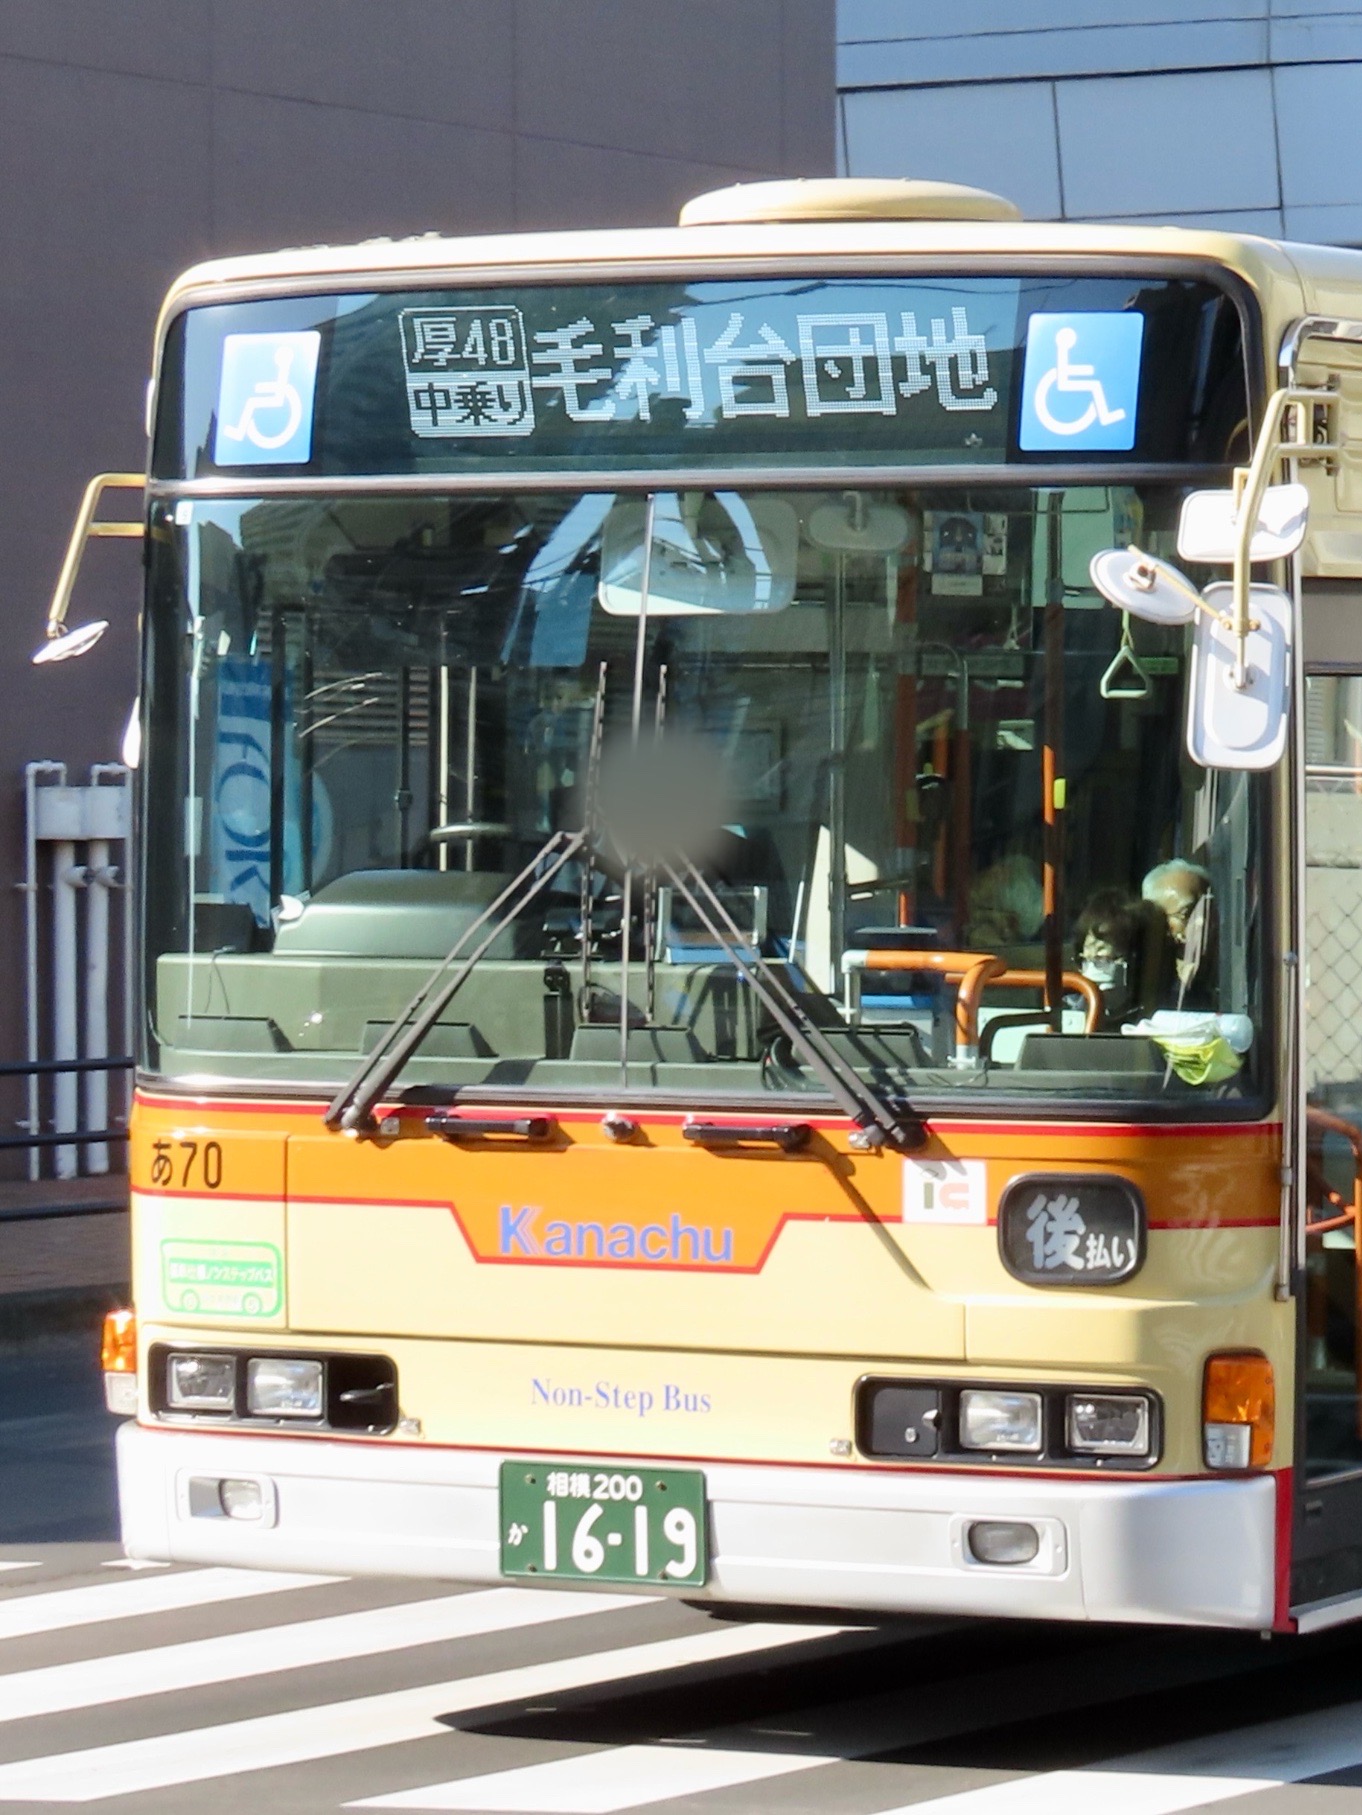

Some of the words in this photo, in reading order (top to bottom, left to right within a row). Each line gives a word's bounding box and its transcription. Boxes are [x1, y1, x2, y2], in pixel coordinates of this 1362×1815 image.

[412, 317, 516, 366] 厚48
[531, 307, 999, 422] 毛利台団地
[413, 381, 527, 427] 中乗り
[151, 1138, 223, 1189] あ70
[500, 1206, 733, 1262] Kanachu
[1025, 1193, 1137, 1270] 後払い
[531, 1377, 654, 1418] Non-Step
[662, 1383, 712, 1413] Bus
[546, 1471, 643, 1502] 相模200
[507, 1522, 529, 1546] か
[543, 1500, 697, 1578] 16-19
